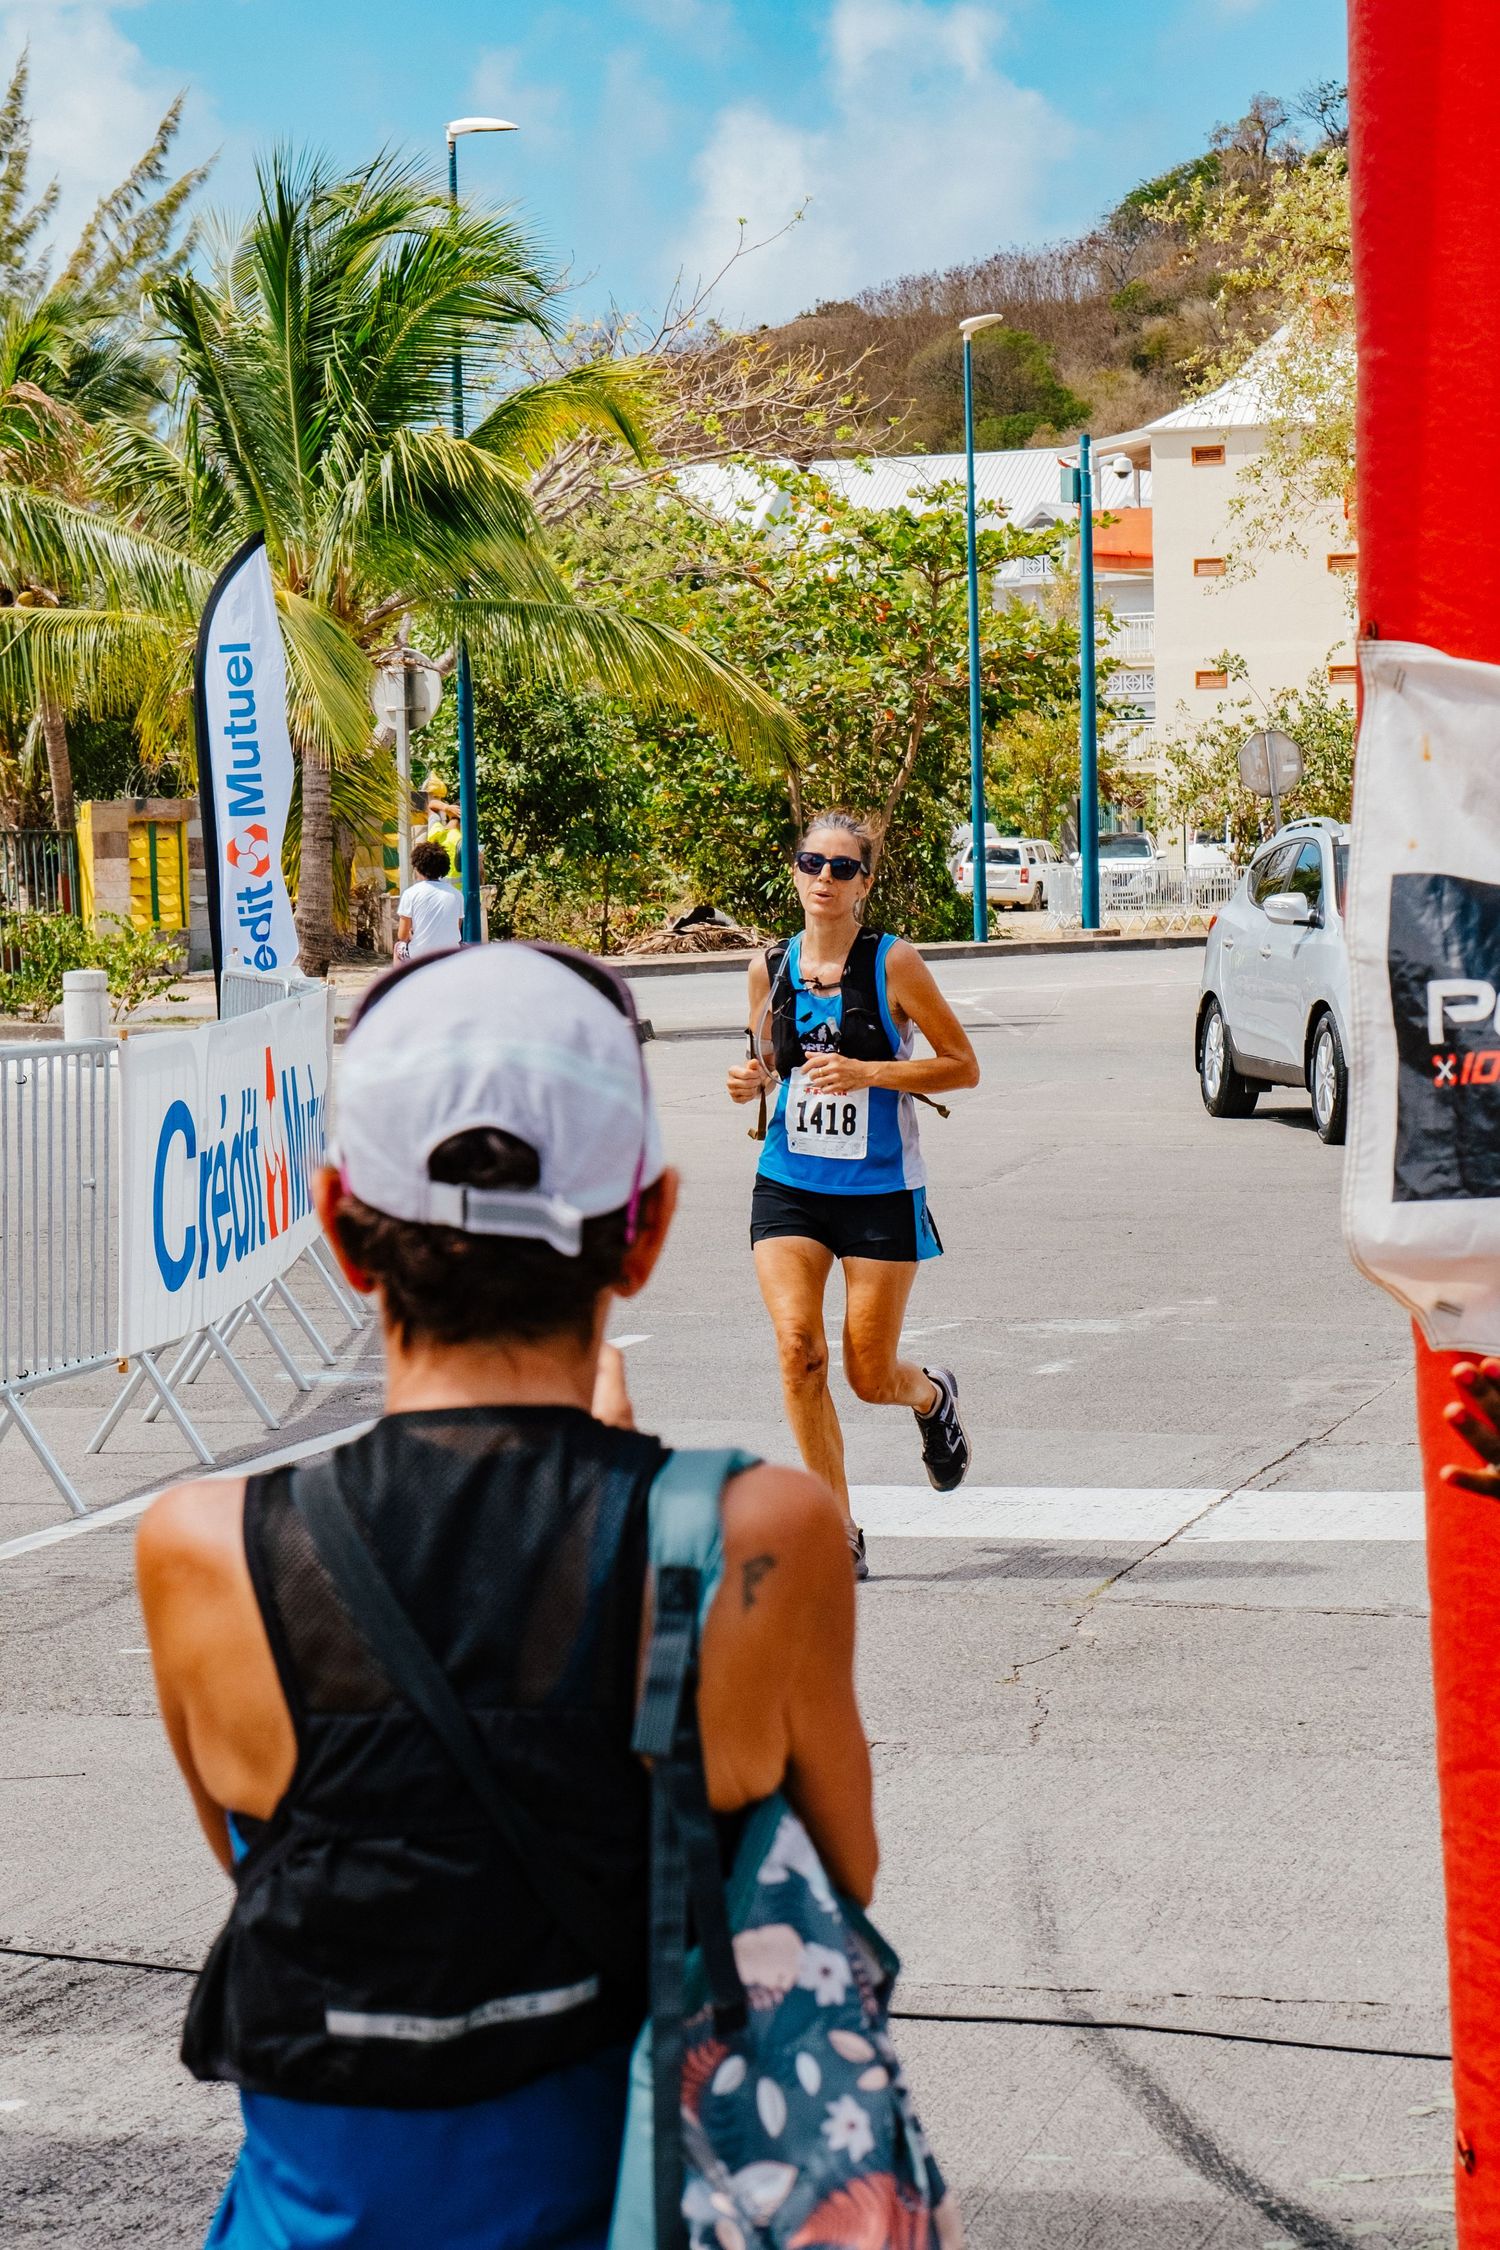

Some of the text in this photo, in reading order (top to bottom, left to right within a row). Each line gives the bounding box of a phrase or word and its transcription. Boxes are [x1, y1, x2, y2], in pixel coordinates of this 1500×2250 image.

[219, 643, 266, 816] Mutuel
[1427, 979, 1500, 1045] P
[796, 1101, 857, 1136] 1418
[153, 1087, 265, 1292] Crédit
